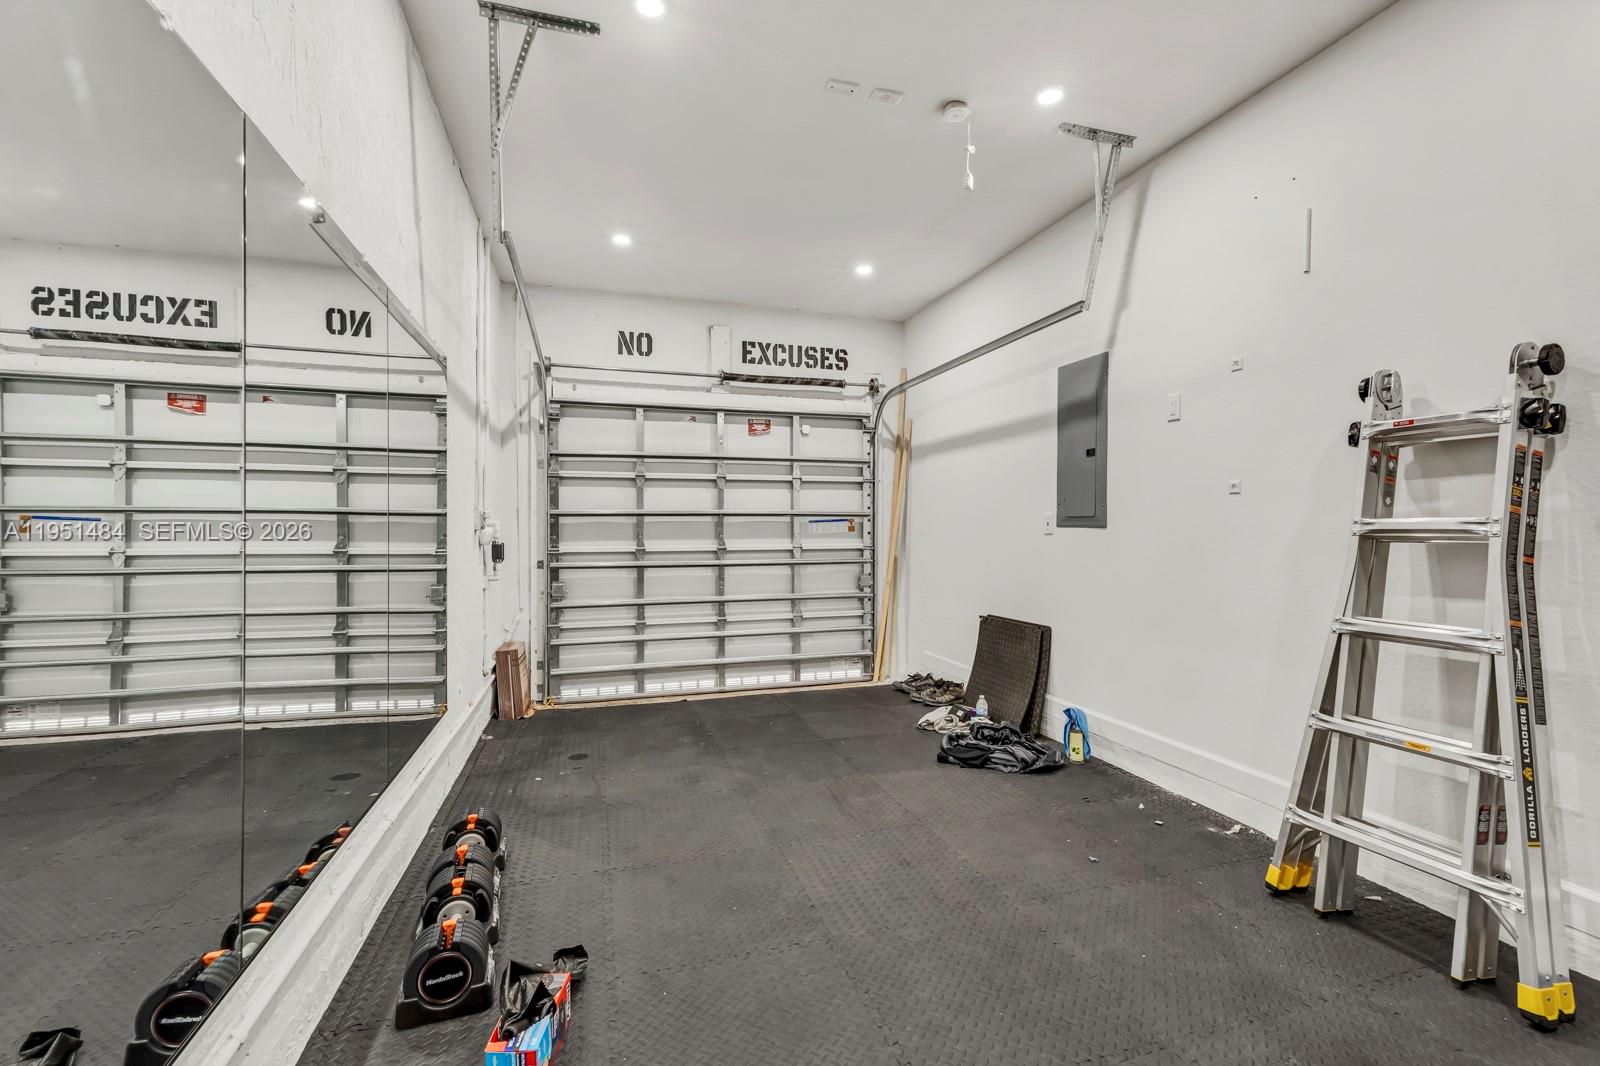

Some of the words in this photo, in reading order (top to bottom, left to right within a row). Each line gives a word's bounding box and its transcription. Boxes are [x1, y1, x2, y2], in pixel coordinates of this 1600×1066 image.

[617, 331, 653, 357] NO
[741, 341, 849, 371] EXCUSES
[1519, 708, 1531, 763] LADDERS
[1525, 785, 1536, 838] GORILLA
